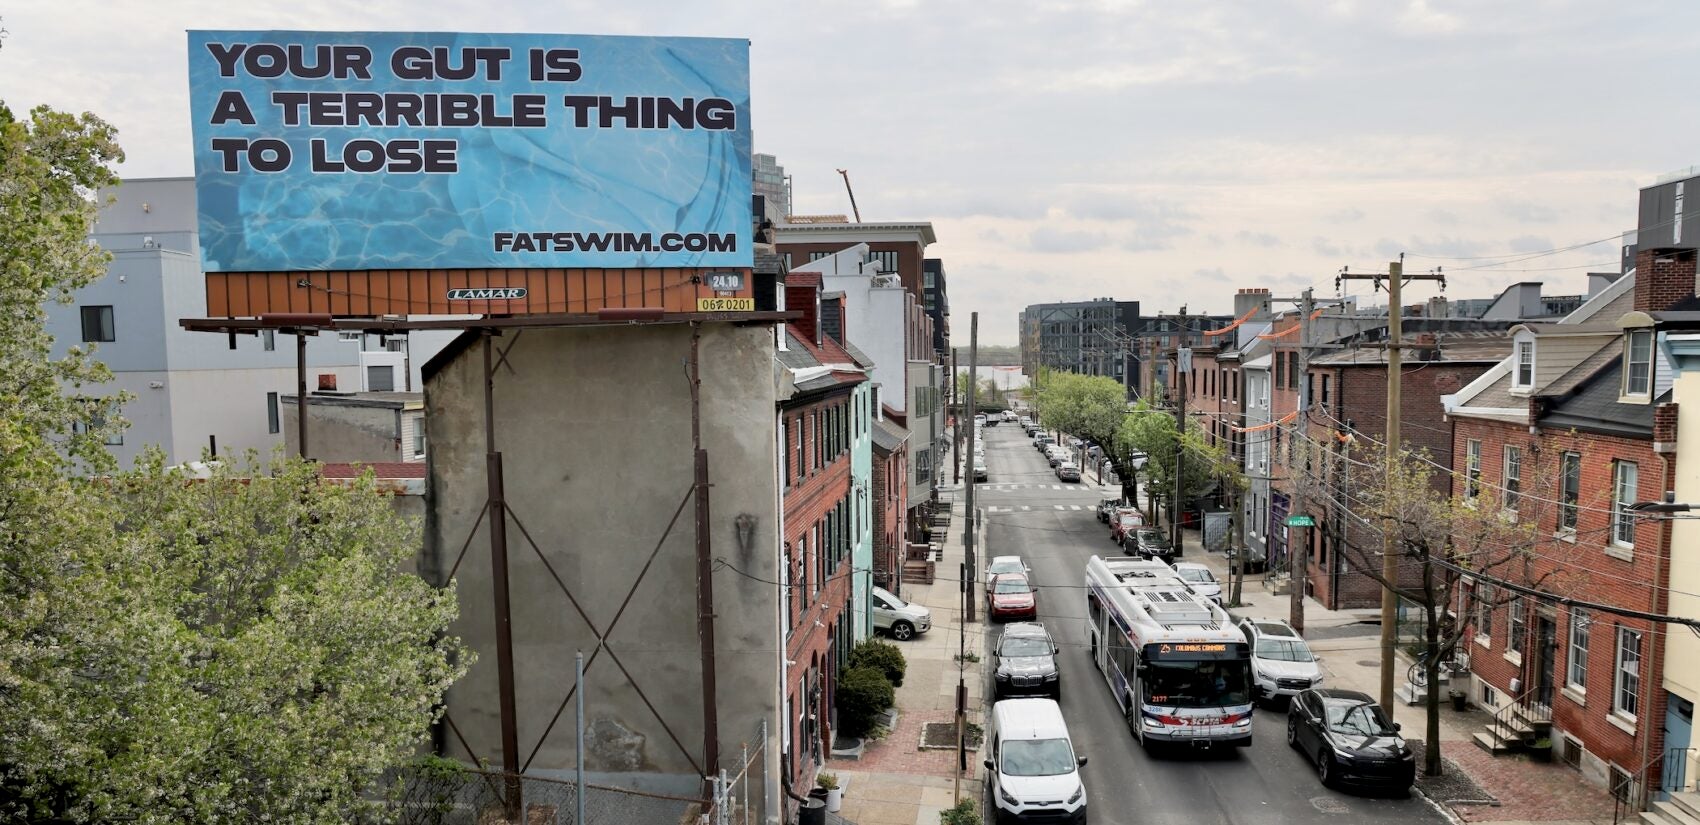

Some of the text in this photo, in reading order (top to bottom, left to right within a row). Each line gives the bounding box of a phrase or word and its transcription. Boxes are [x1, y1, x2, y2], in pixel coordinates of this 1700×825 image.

[207, 42, 582, 82] YOUR GUT IS
[210, 91, 736, 131] A TERRIBLE THING
[212, 138, 458, 174] TO LOSE
[493, 232, 737, 254] FATSWIM.COM
[713, 275, 739, 288] 24.10
[453, 288, 519, 299] LAMAR
[1160, 644, 1226, 654] 25 COLUMBUS COMMONS
[1152, 695, 1168, 703] 2177
